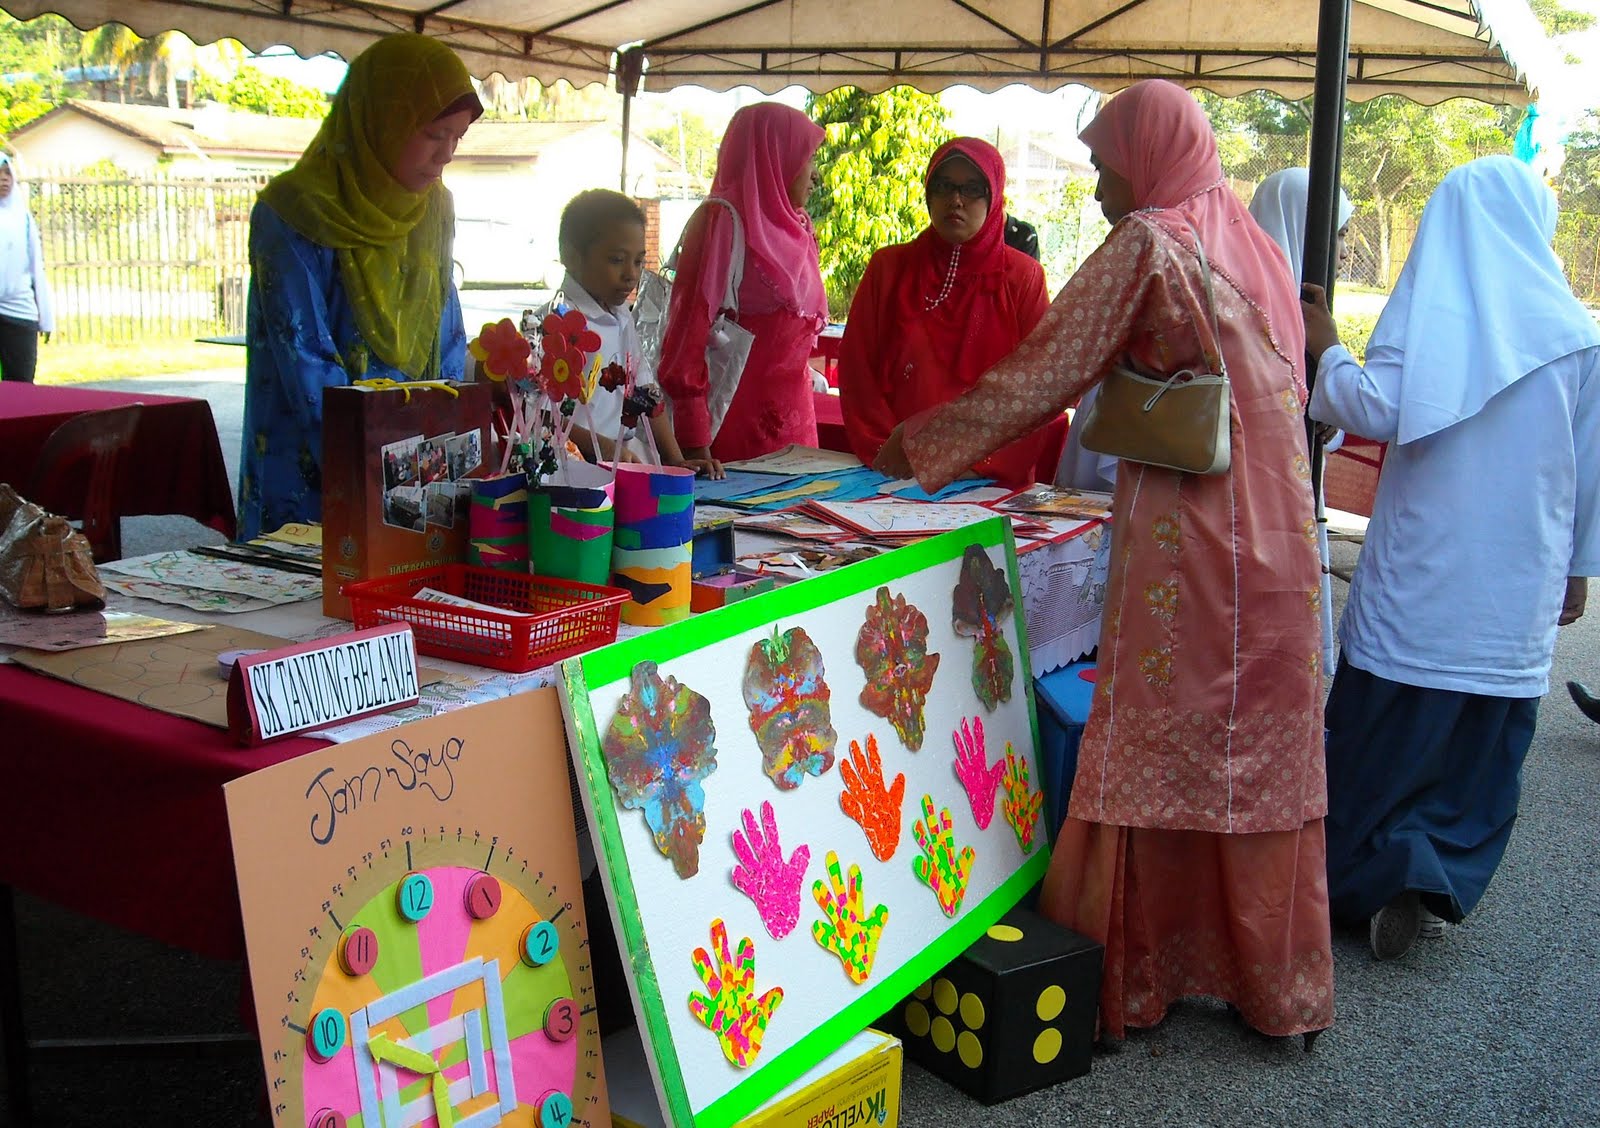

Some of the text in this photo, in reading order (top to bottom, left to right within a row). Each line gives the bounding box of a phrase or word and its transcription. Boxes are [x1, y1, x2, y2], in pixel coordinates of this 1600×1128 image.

[253, 632, 417, 735] SK TANJUNG BELANJA
[306, 738, 464, 845] Jam Saya
[492, 836, 498, 845] 5
[409, 880, 430, 911] 12
[482, 887, 493, 908] 1
[357, 935, 369, 962] 11
[536, 929, 552, 956] 2
[321, 1016, 338, 1049] 10
[558, 1006, 573, 1034] 3
[550, 1101, 566, 1125] 4
[815, 1101, 865, 1128] YELLO
